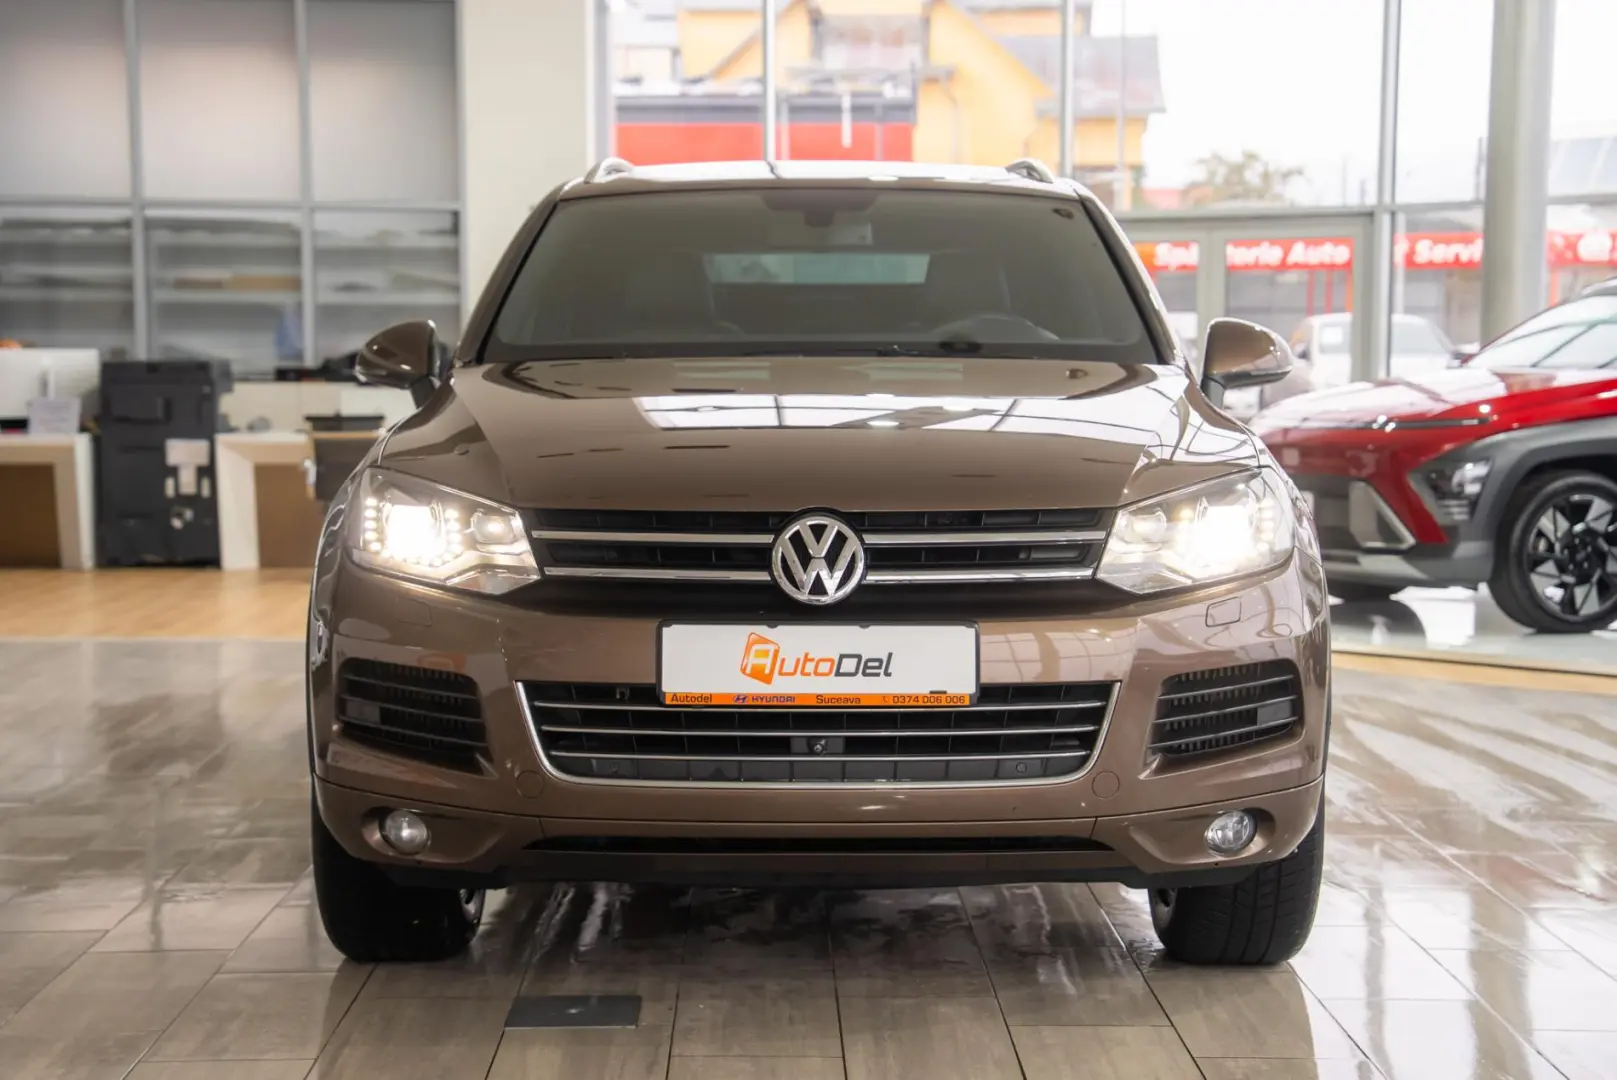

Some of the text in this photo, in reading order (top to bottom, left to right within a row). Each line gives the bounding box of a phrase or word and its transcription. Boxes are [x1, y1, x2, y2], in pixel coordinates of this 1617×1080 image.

[1287, 241, 1350, 265] Auto
[744, 640, 893, 678] AutoDel
[671, 693, 965, 704] Autodel HYUNDAI Suceava 0374 006 006
